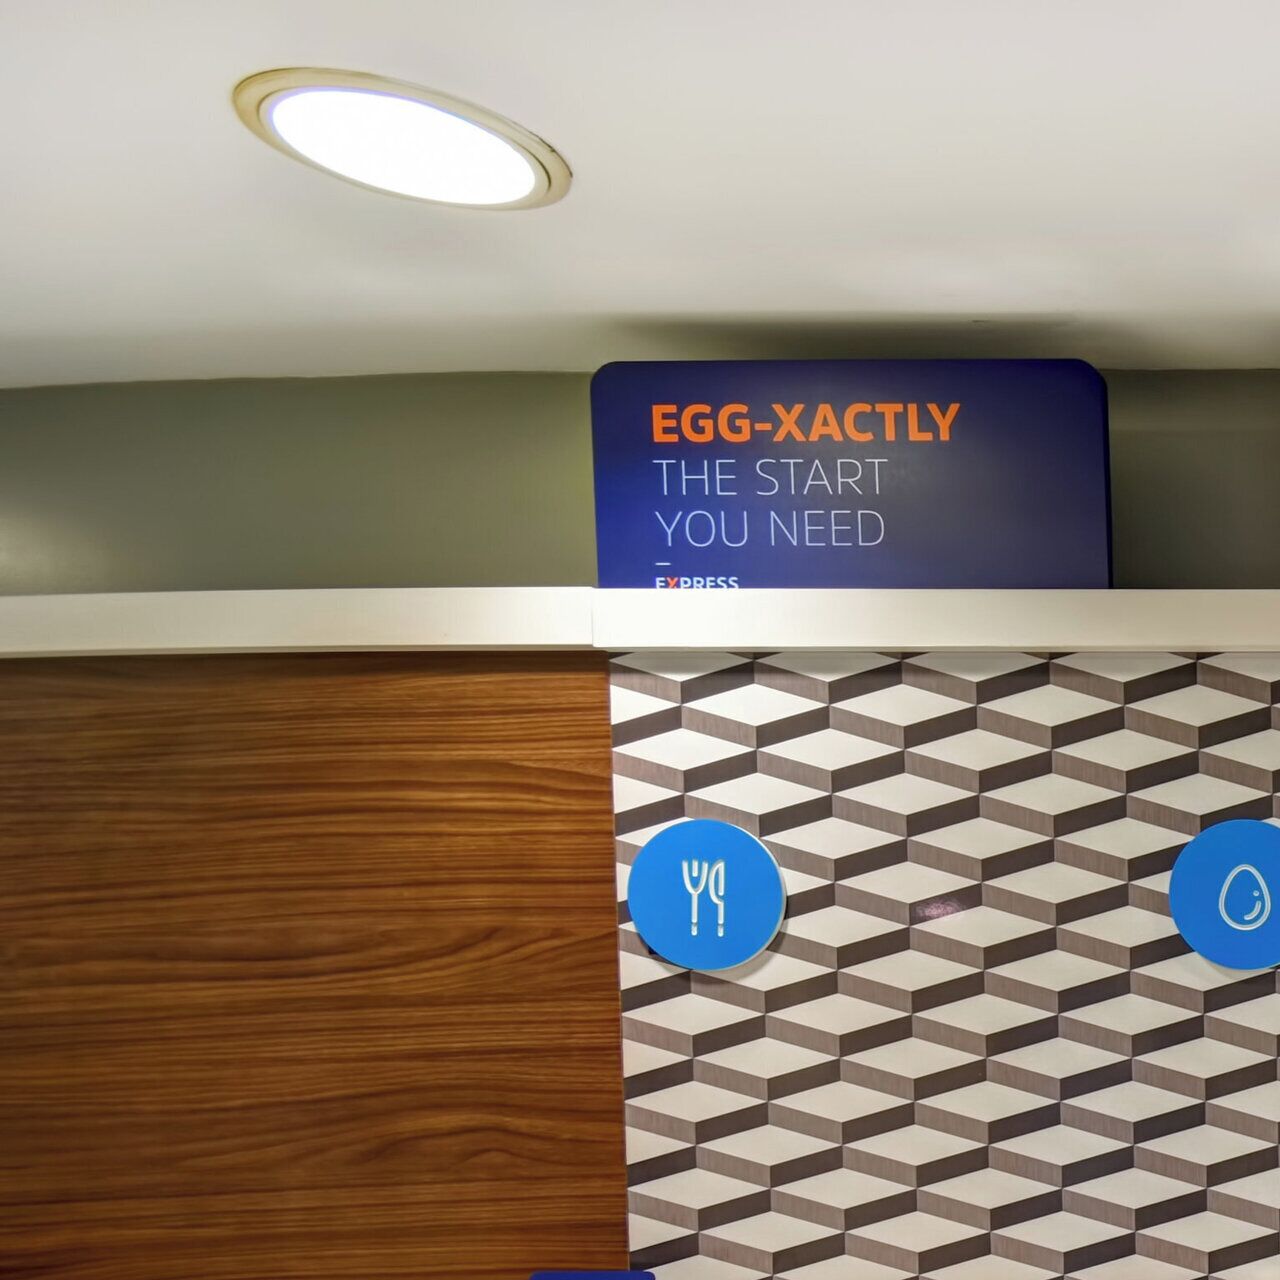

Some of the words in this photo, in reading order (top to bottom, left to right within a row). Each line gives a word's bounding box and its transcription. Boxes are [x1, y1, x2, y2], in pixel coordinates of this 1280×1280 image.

[652, 403, 960, 443] EGG-XACTLY
[652, 459, 738, 496] THE
[756, 458, 888, 496] START
[654, 510, 749, 547] YOU
[769, 510, 885, 547] NEED
[655, 577, 740, 589] EXPRESS
